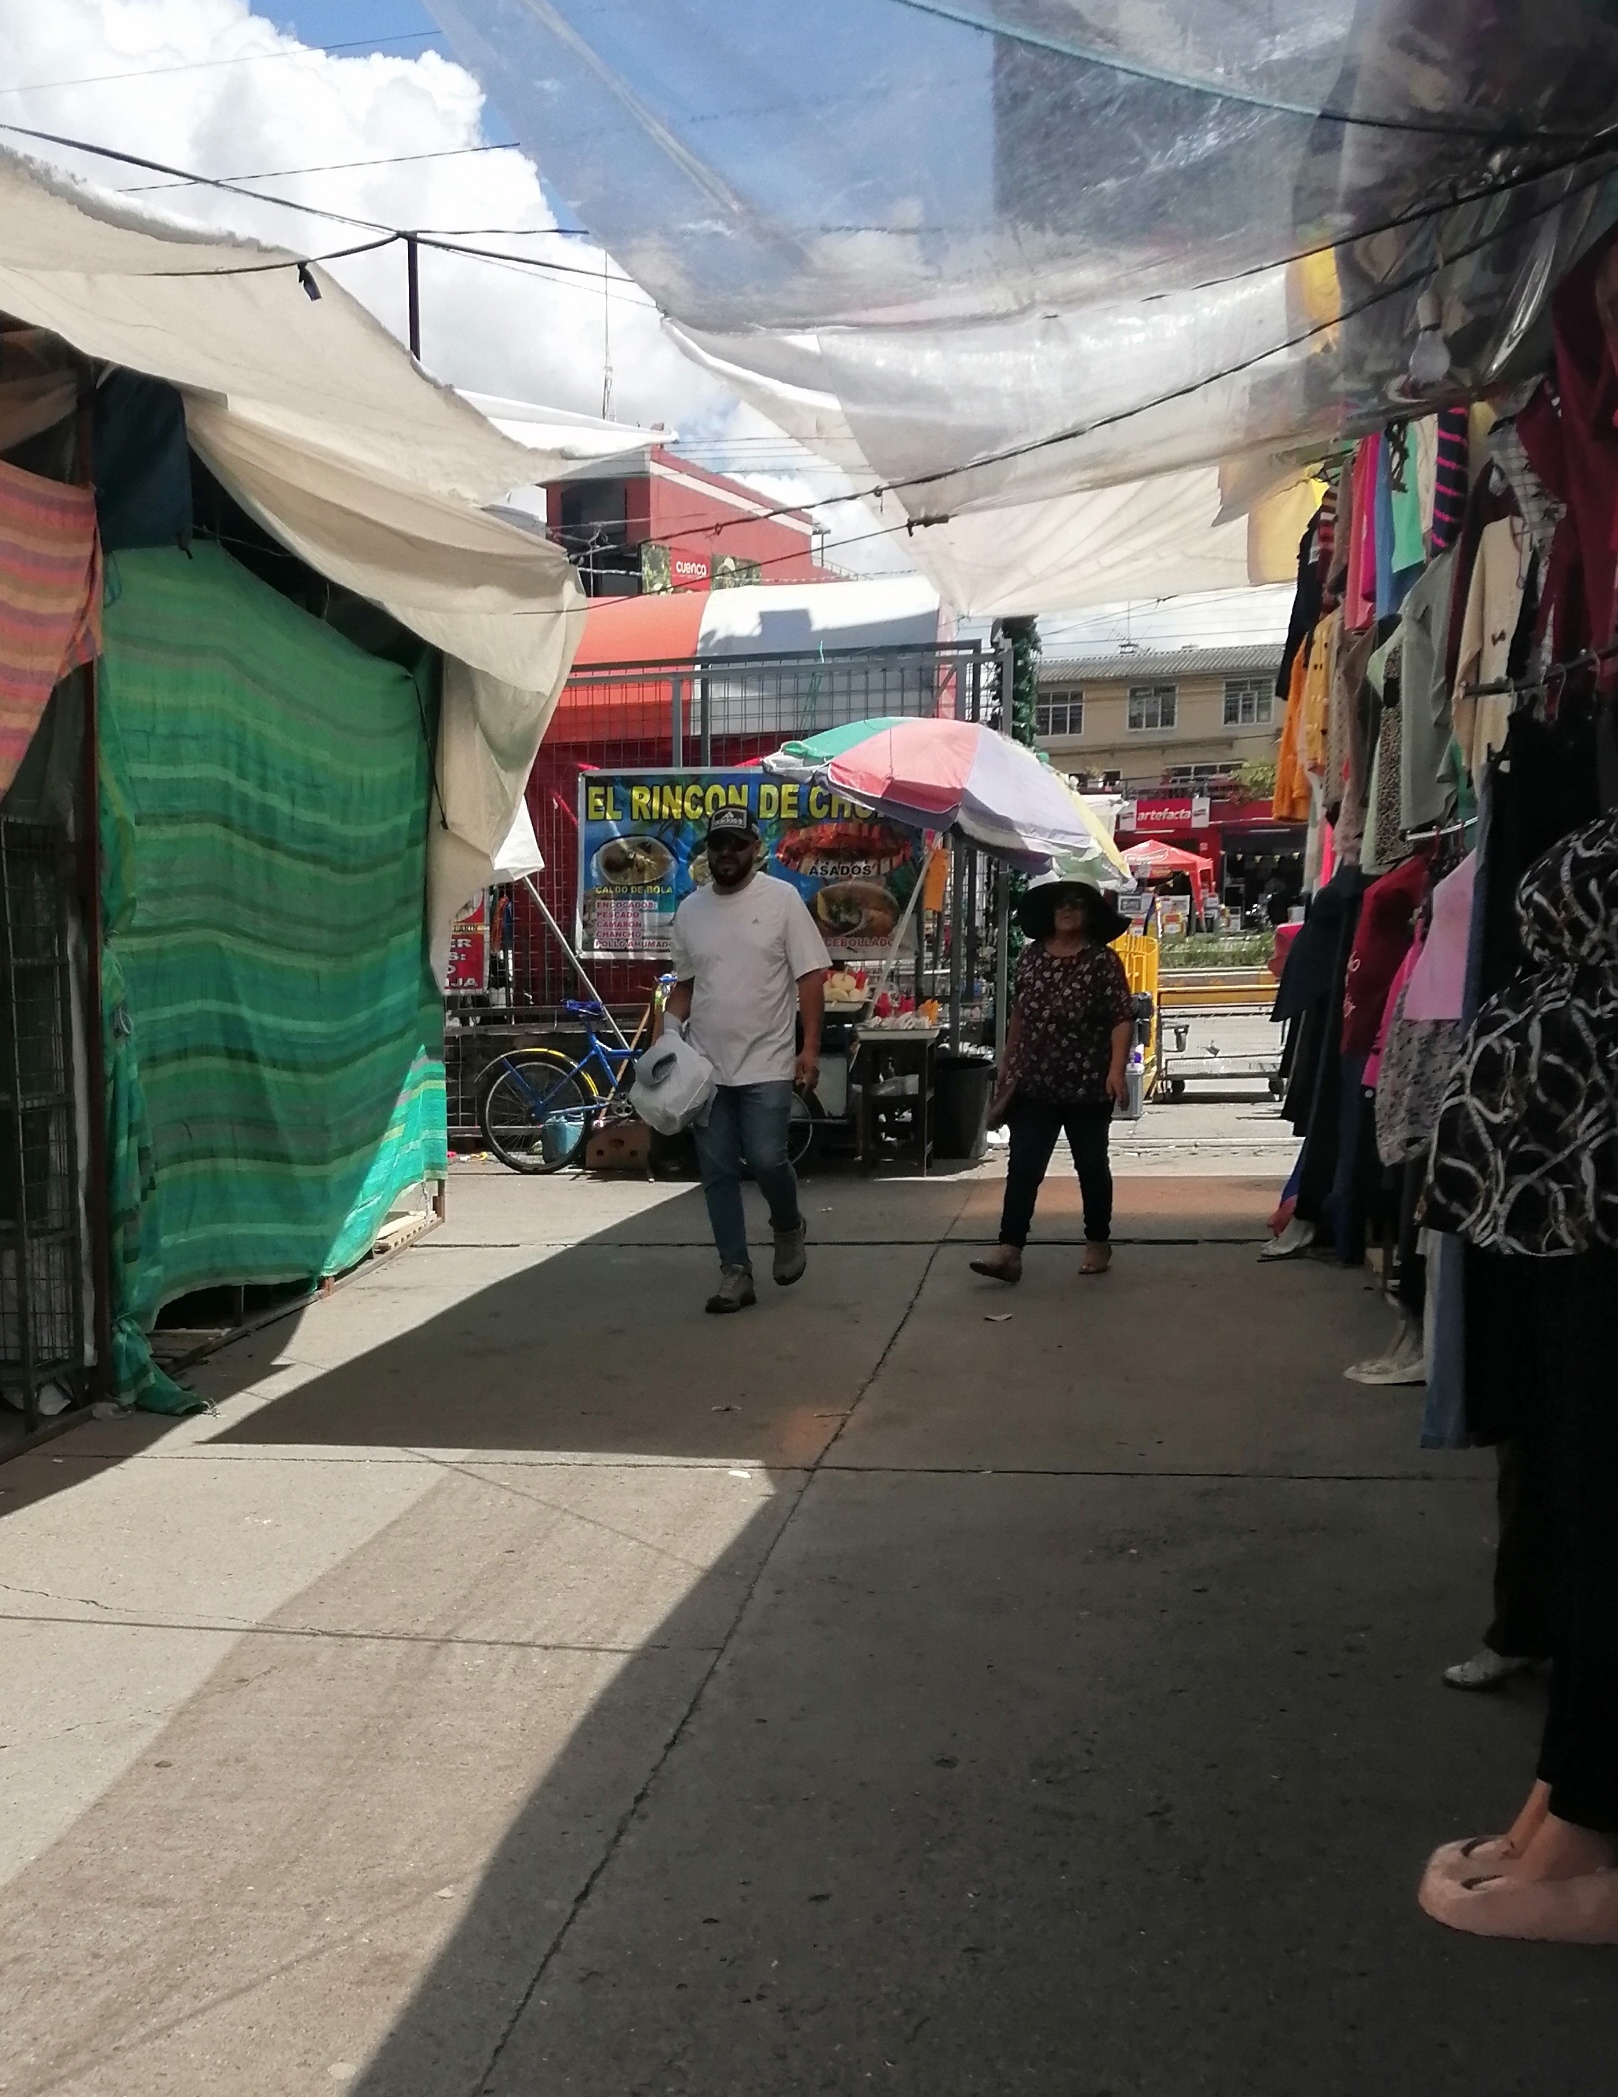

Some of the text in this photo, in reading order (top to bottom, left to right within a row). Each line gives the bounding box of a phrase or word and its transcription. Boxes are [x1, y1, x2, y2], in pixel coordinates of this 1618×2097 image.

[587, 786, 623, 821] EL
[631, 784, 749, 821] RINCON
[758, 783, 799, 820] DE
[1136, 807, 1192, 822] artefacta
[808, 865, 872, 877] ASADOS
[595, 885, 628, 895] CALDO
[630, 885, 644, 894] DE
[596, 911, 640, 919] PESCADO
[596, 930, 641, 939] CHANCHO
[595, 940, 625, 949] POLLO
